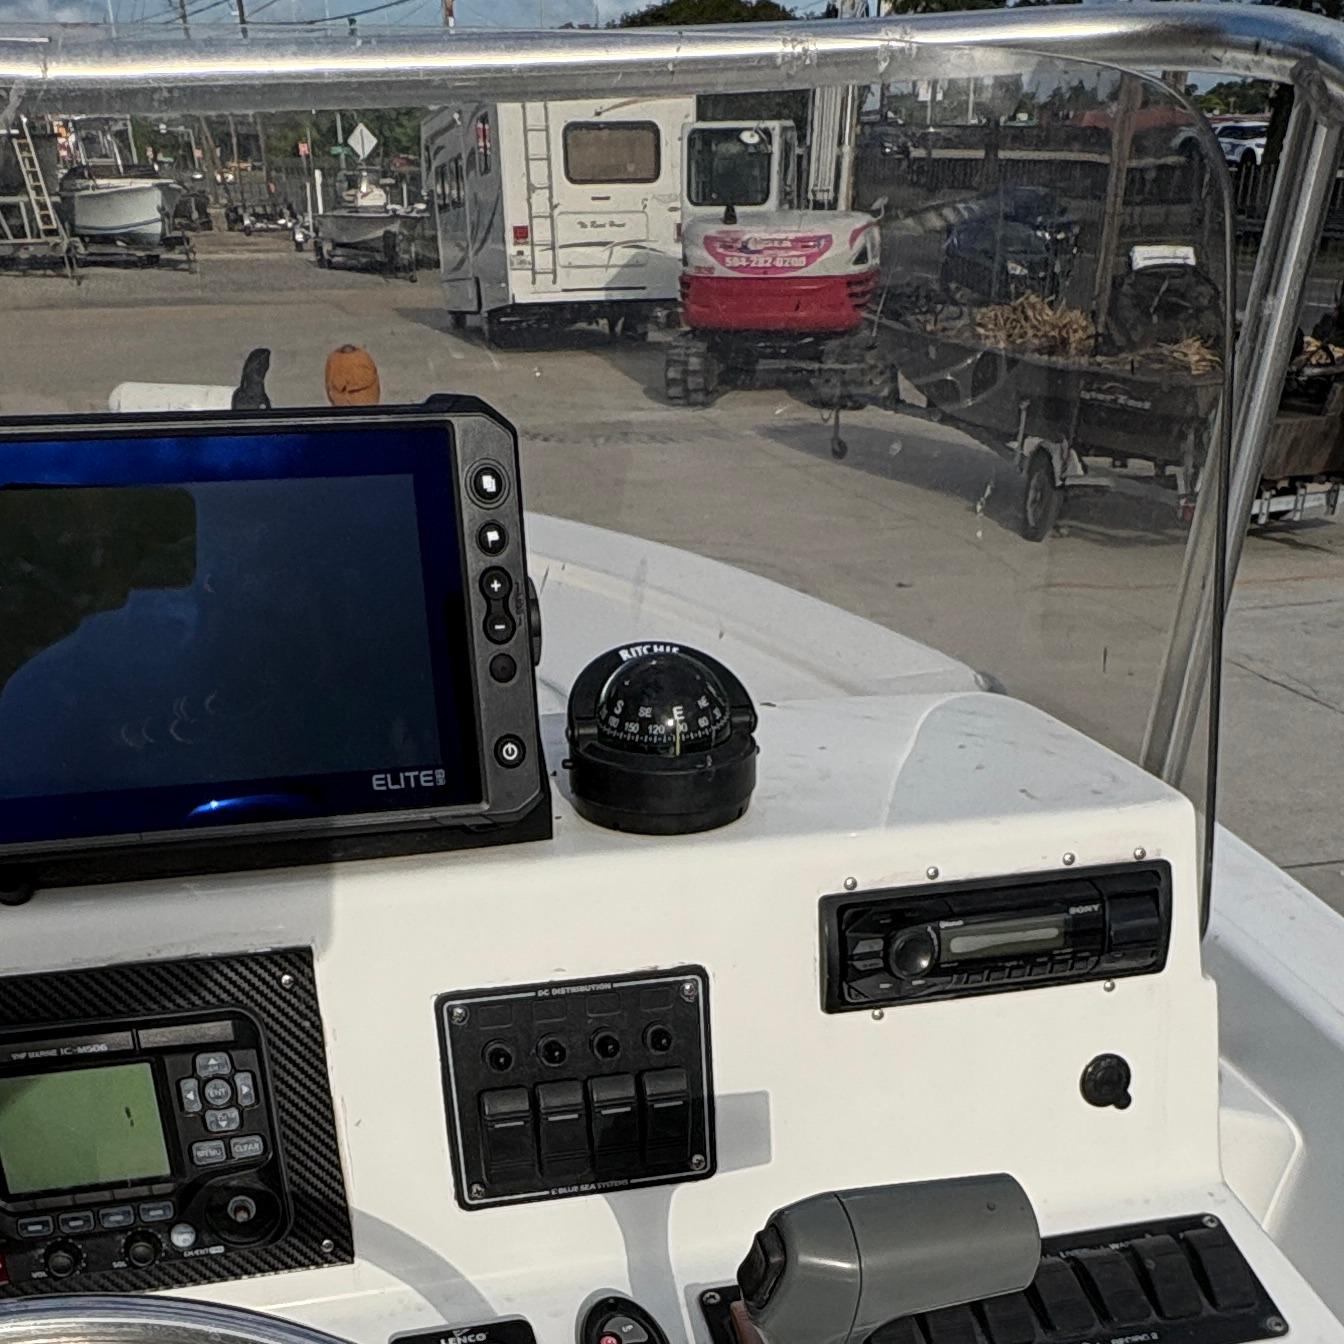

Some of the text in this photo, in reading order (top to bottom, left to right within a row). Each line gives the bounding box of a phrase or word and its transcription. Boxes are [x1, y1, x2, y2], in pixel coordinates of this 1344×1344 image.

[618, 644, 680, 661] RITCHIE
[613, 699, 625, 715] S
[638, 705, 653, 719] SE
[672, 705, 685, 721] E
[624, 720, 640, 734] 150
[647, 722, 666, 735] 120
[371, 769, 435, 791] ELITE
[1068, 902, 1102, 915] SONY
[537, 982, 612, 998] DC DISTRIBUTION
[621, 1324, 634, 1333] UP
